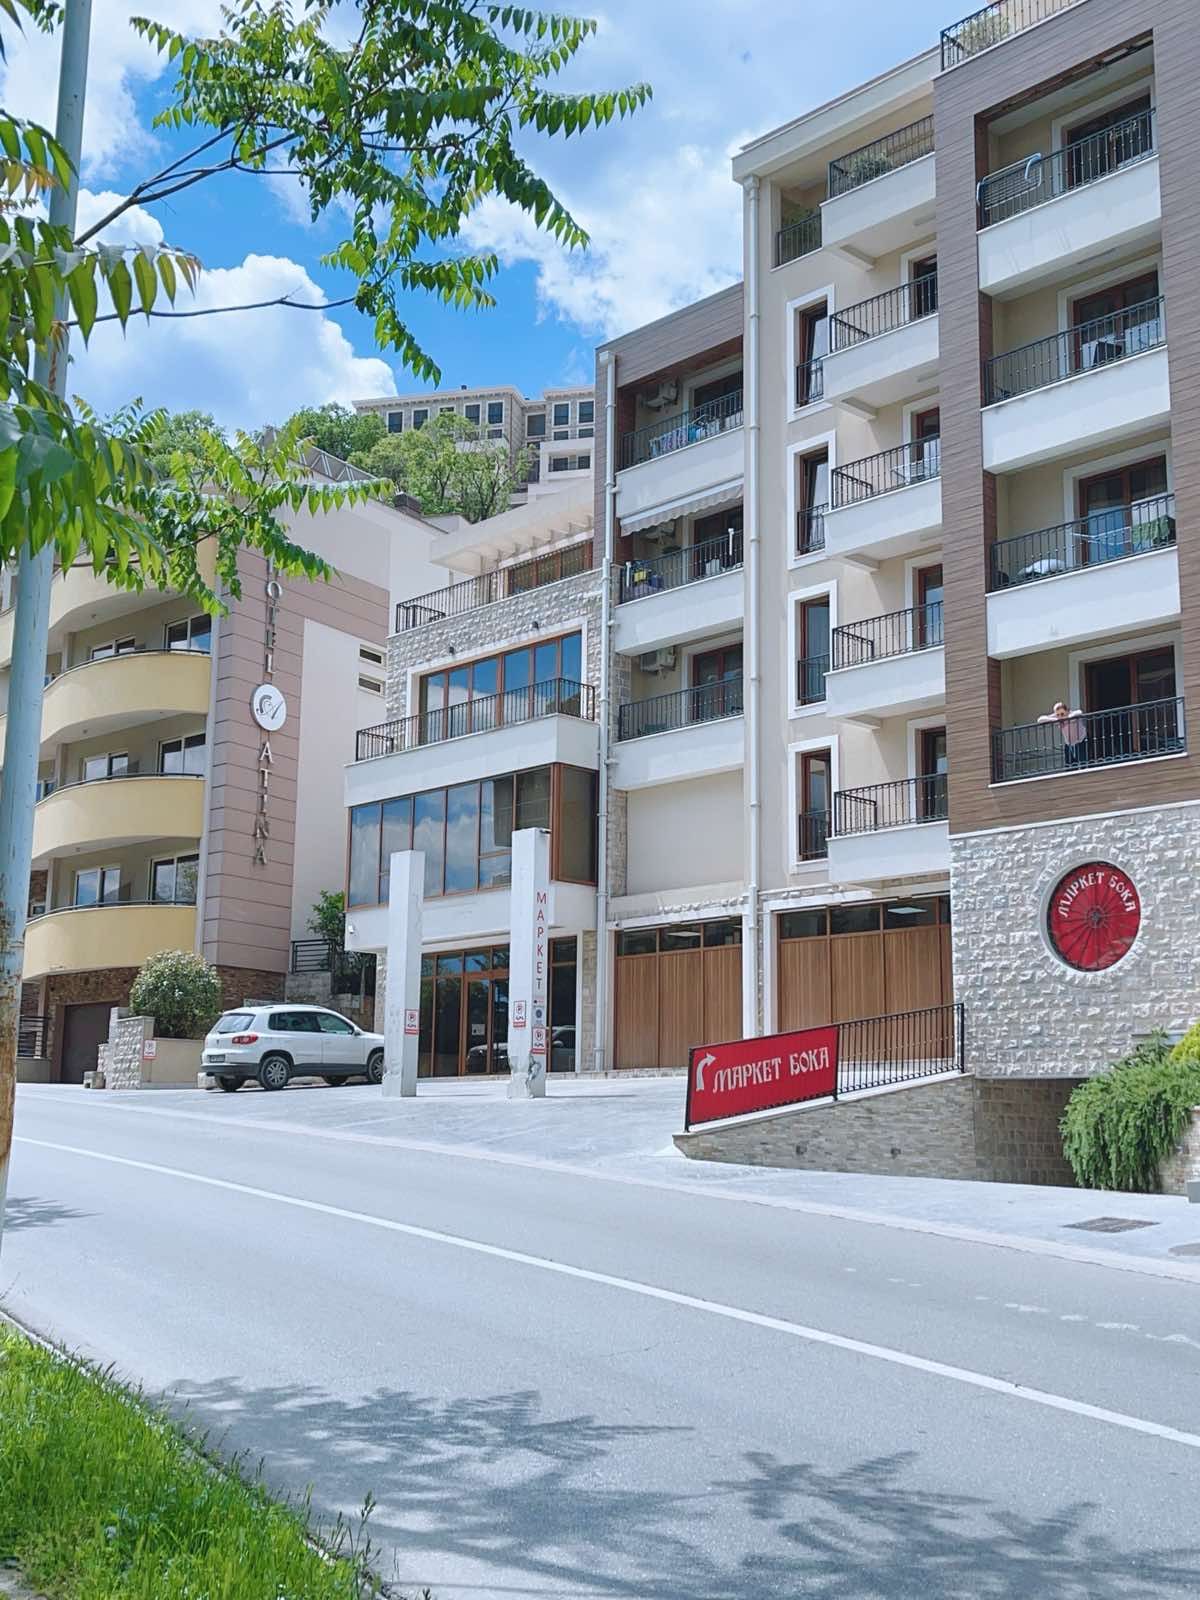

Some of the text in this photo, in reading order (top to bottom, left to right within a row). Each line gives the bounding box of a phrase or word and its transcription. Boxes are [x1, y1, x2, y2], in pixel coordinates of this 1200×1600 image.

[1058, 871, 1137, 918] МАРКЕТ БОКА
[536, 892, 547, 990] МАРКЕТ
[712, 1046, 830, 1094] МАРКЕТ БОКА
